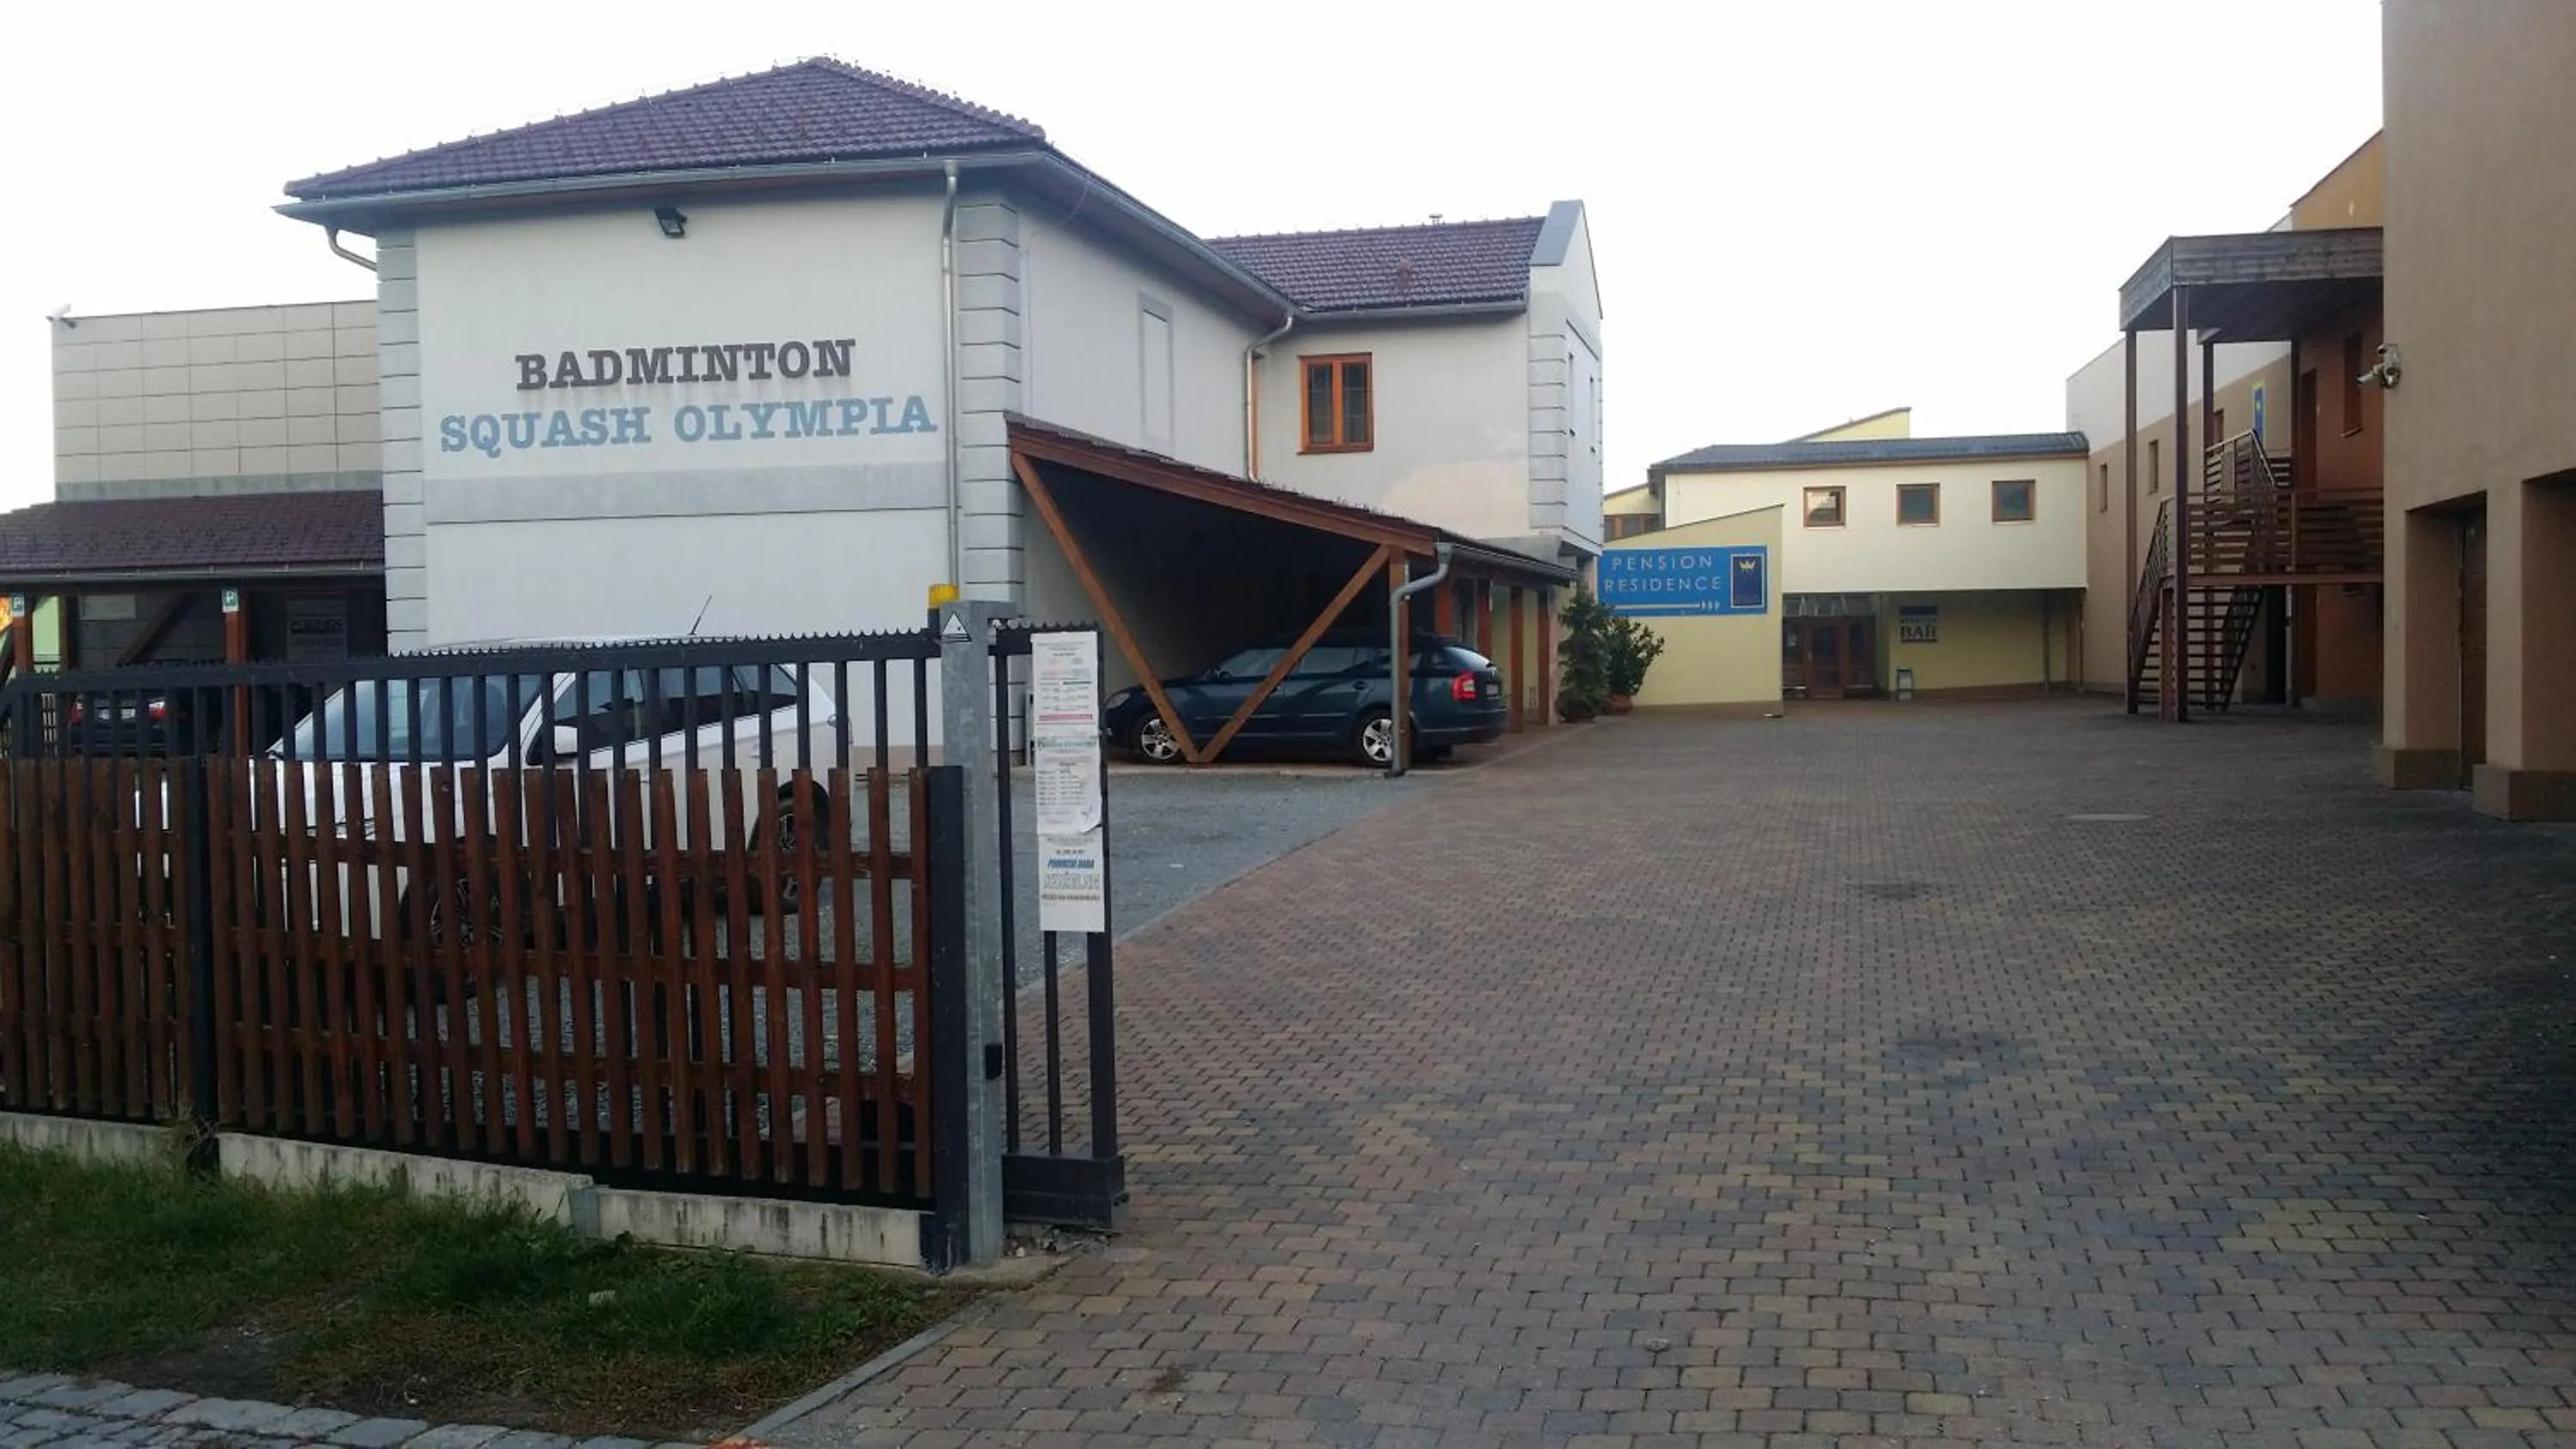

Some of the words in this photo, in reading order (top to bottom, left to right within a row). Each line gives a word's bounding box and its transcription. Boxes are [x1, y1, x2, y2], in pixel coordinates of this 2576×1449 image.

[515, 339, 856, 391] BADMINTON
[440, 405, 652, 458] SQUASH
[674, 396, 938, 442] OLYMPIA
[1612, 555, 1713, 571] PENSION
[1604, 576, 1722, 591] RESIDENCE
[1900, 625, 1938, 638] BAR
